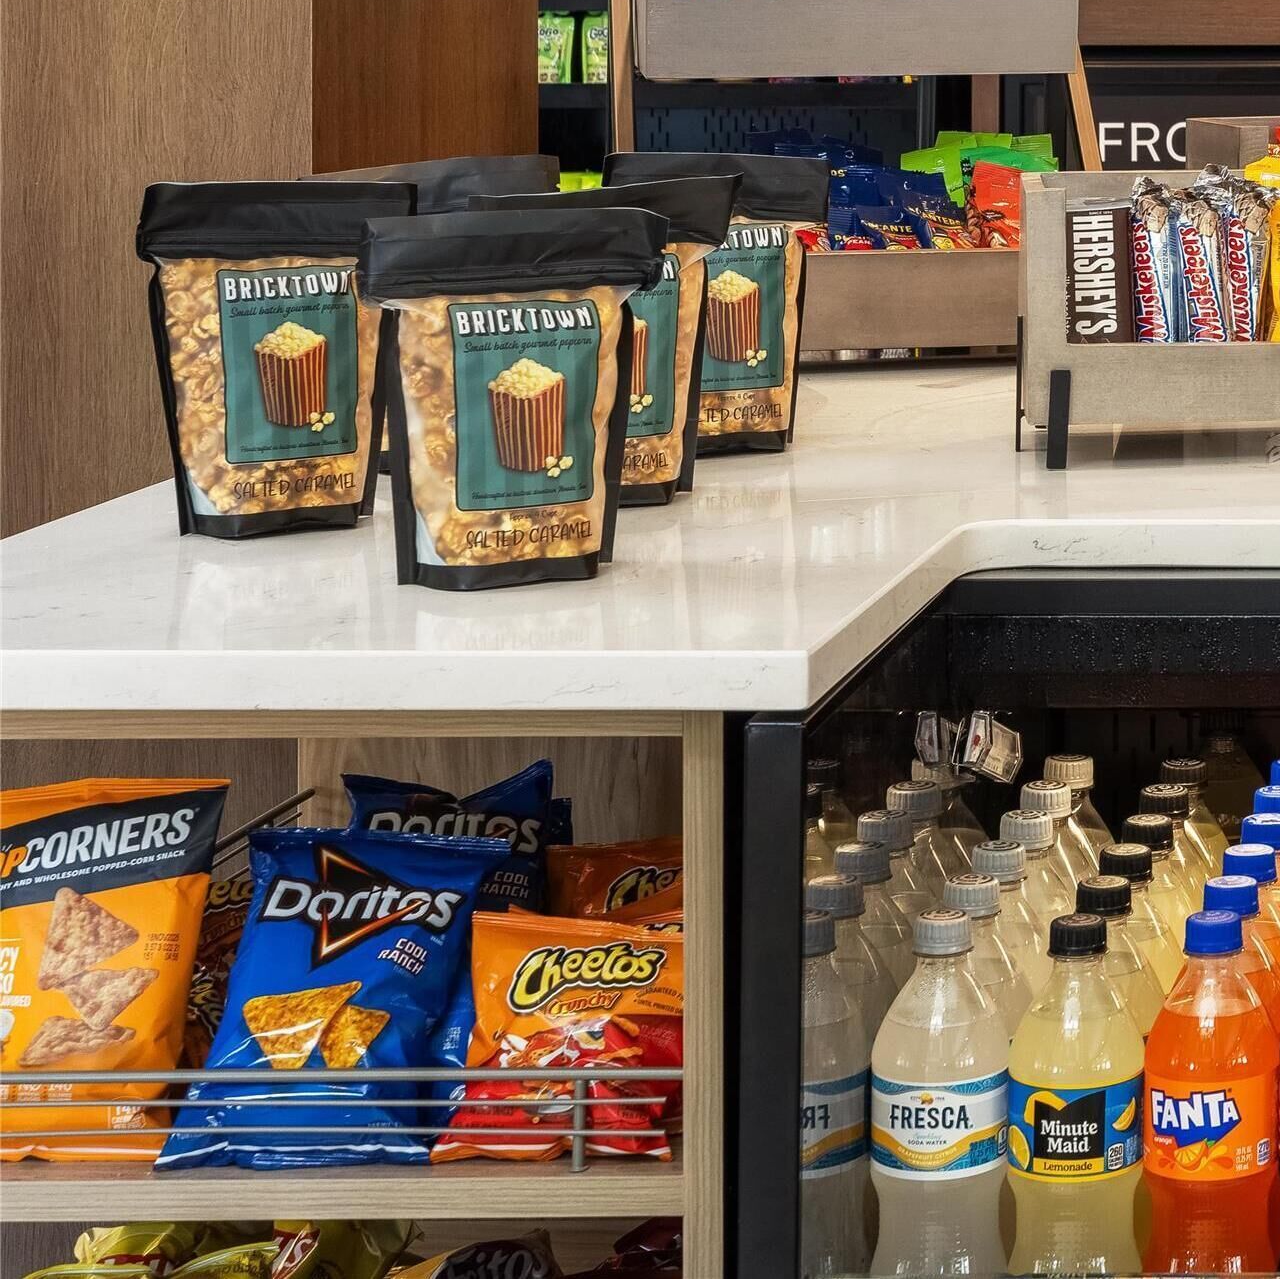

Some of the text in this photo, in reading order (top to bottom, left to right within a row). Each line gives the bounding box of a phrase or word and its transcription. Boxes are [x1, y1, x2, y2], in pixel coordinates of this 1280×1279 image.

[224, 271, 350, 301] BRICKTOWN
[1072, 215, 1118, 336] HERSHEY'S
[1133, 222, 1170, 343] Musketeers
[1179, 226, 1226, 343] Musketeers
[229, 303, 320, 318] Small batch gourmet
[456, 306, 593, 336] BRICKTOWN
[464, 337, 593, 354] Small batch gourmet popcorn
[733, 403, 784, 421] CARAMEL
[233, 472, 357, 500] SALTED CARAMEL
[465, 520, 593, 550] SALTED CARAMEL
[12, 849, 187, 890] AND WHOLESOME POPPED-CORN SNACK
[494, 871, 529, 886] COOL
[262, 878, 468, 930] Doritos
[377, 946, 426, 976] RANCH
[396, 936, 428, 962] COOL
[509, 943, 665, 1011] Cheetos
[544, 989, 622, 1019] Crunchy
[889, 1104, 970, 1130] FRESCA
[1151, 1089, 1240, 1131] FANTA
[1040, 1119, 1098, 1136] Minute
[1153, 1136, 1173, 1145] orange
[1047, 1136, 1090, 1153] Maid
[1109, 1146, 1123, 1157] 260
[1042, 1160, 1093, 1172] Lemonade
